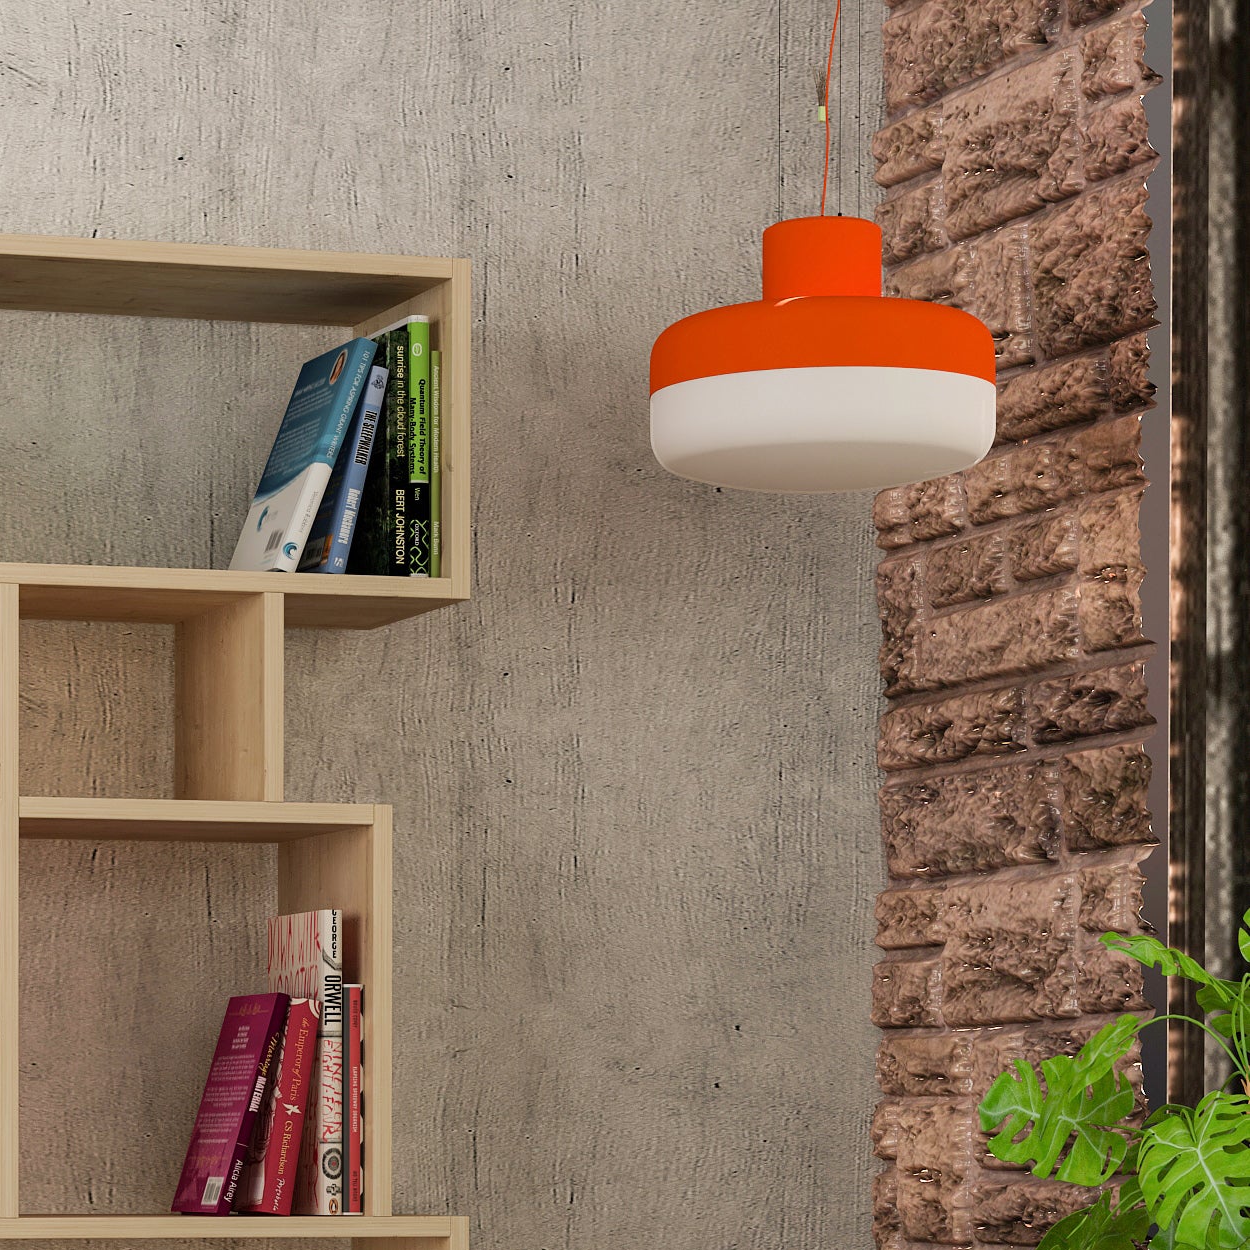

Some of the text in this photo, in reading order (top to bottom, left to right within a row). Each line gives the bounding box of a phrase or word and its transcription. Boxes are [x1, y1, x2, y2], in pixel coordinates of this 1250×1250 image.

[343, 386, 356, 414] ASPIRING
[396, 346, 406, 458] sunrise in the cloud forest
[336, 414, 347, 434] GRANT
[354, 410, 378, 466] THE SLEEPWALKER
[326, 434, 339, 458] WRITERS
[418, 437, 426, 464] Theory
[419, 465, 426, 475] of
[396, 490, 406, 564] BERT JOHNSTON
[324, 975, 342, 1026] ORWELL
[301, 1017, 310, 1028] the
[294, 1028, 308, 1070] Emperor
[248, 1076, 266, 1112] MATERIAL
[290, 1078, 302, 1101] Paris
[278, 1120, 293, 1174] CS Richardson
[224, 1158, 244, 1203] Alicia Airey
